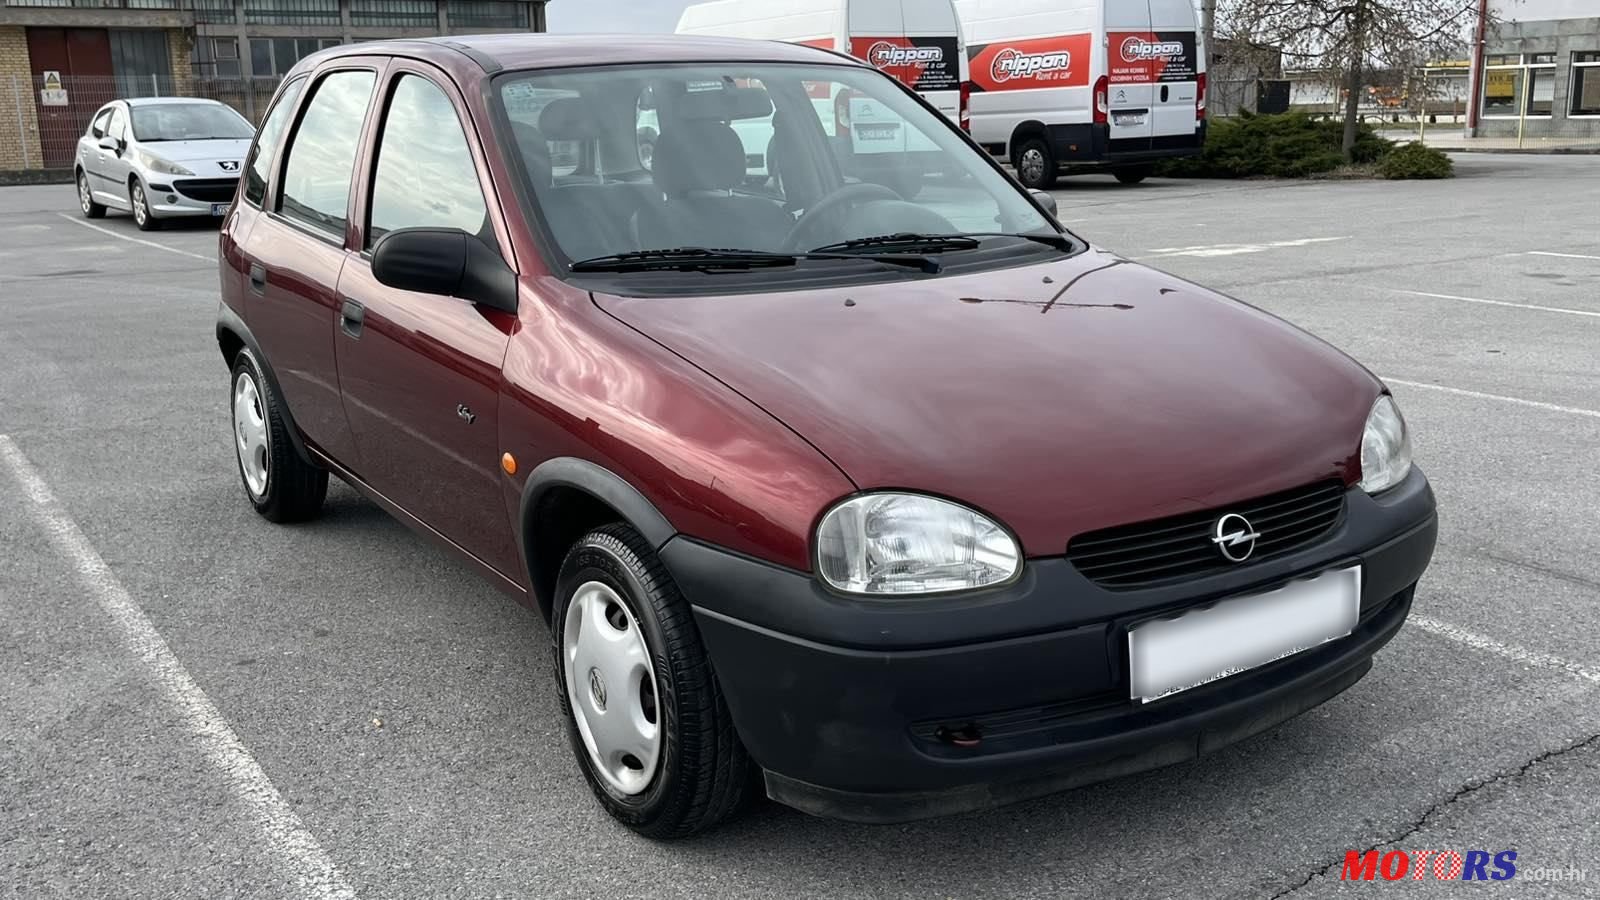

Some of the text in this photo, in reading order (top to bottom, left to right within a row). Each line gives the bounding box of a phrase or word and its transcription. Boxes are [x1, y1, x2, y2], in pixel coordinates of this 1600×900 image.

[877, 46, 941, 65] nippon
[1128, 41, 1182, 57] nippon
[999, 53, 1069, 76] nippon
[1036, 71, 1052, 80] Rent
[1060, 71, 1072, 79] car
